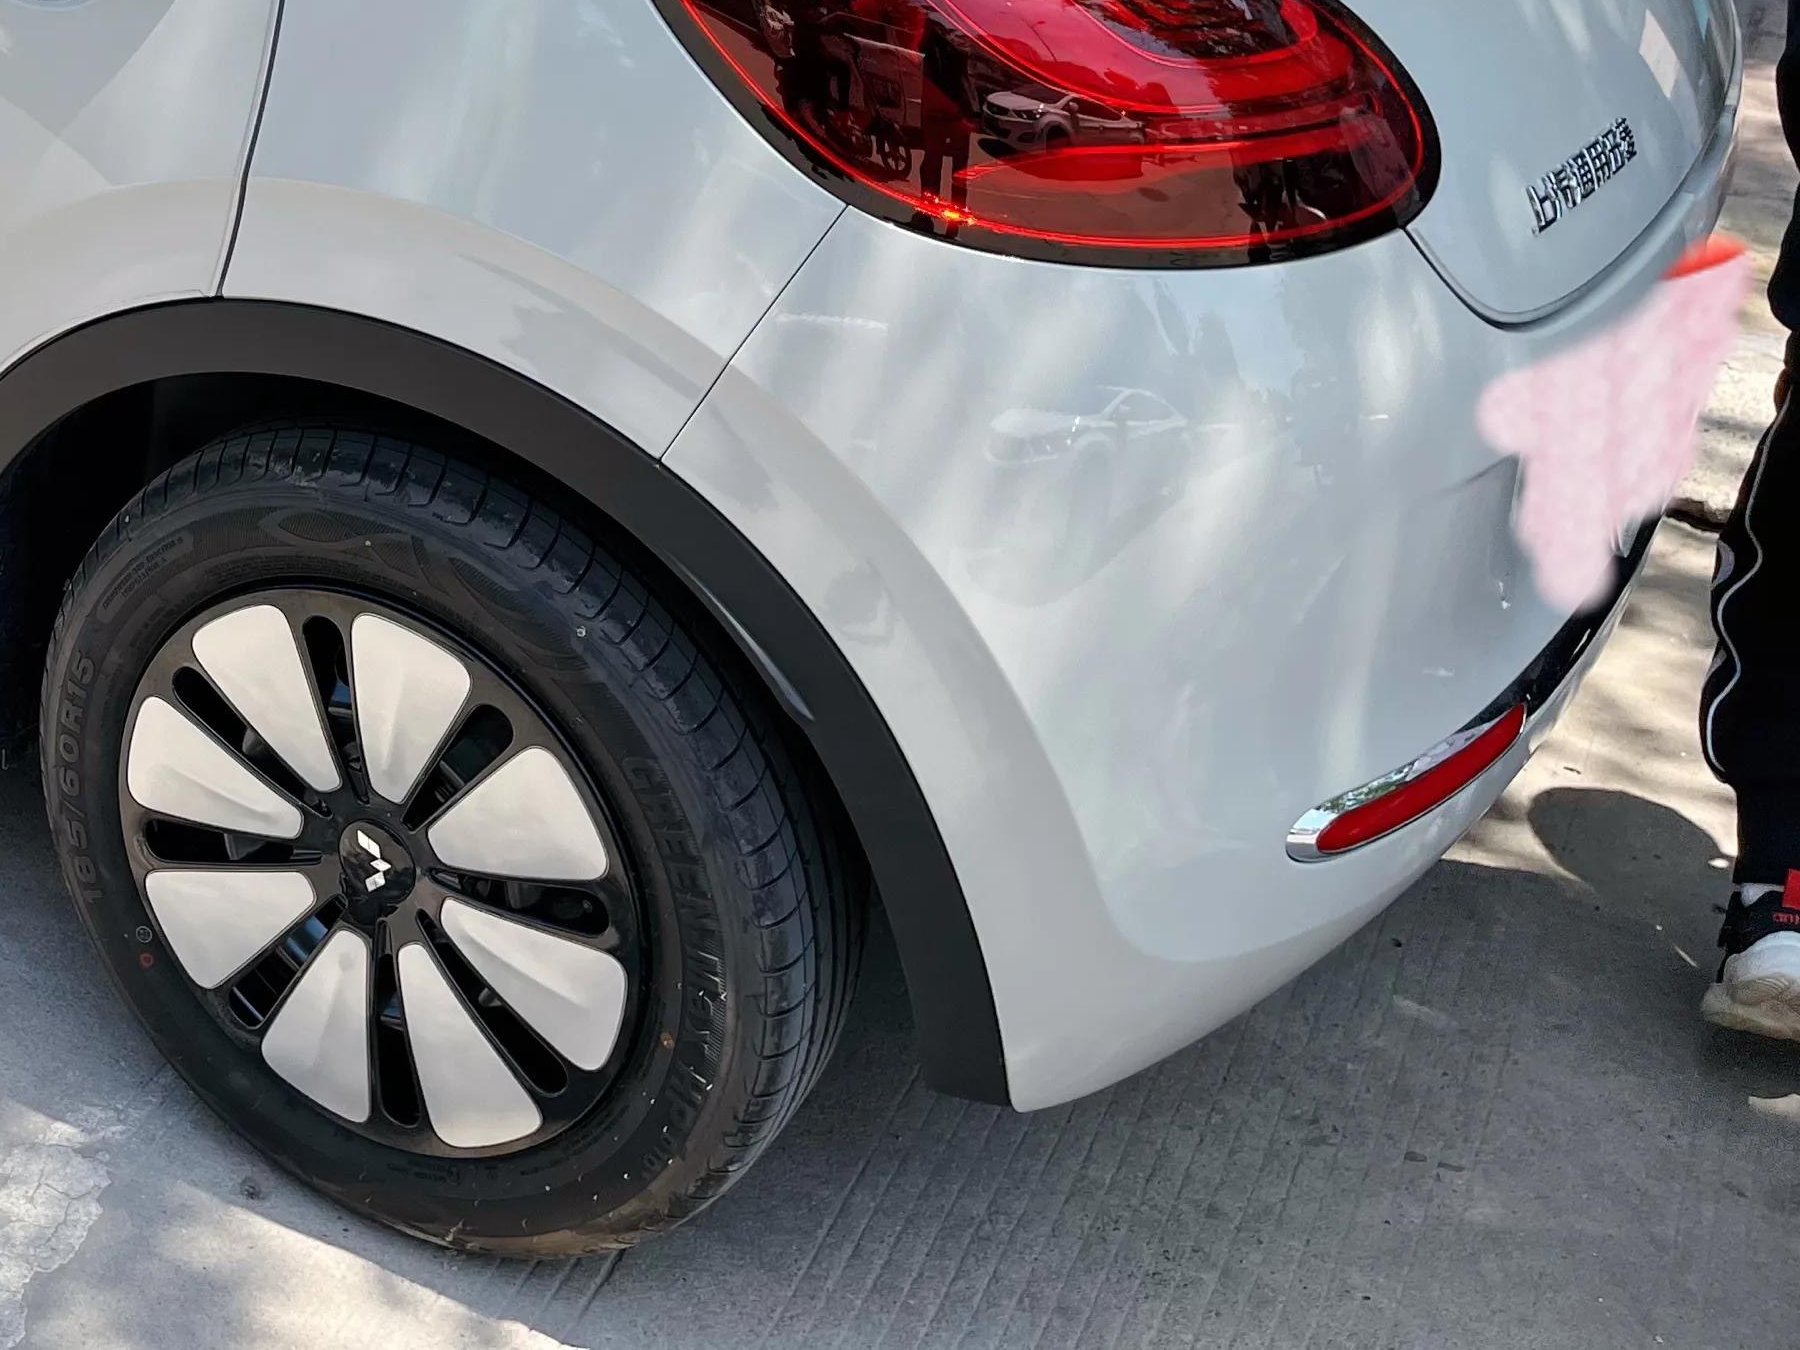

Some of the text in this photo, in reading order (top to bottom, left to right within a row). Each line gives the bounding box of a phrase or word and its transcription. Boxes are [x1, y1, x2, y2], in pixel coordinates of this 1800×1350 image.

[1525, 116, 1638, 237] 上汽通用五菱
[57, 650, 103, 905] 185/60R15
